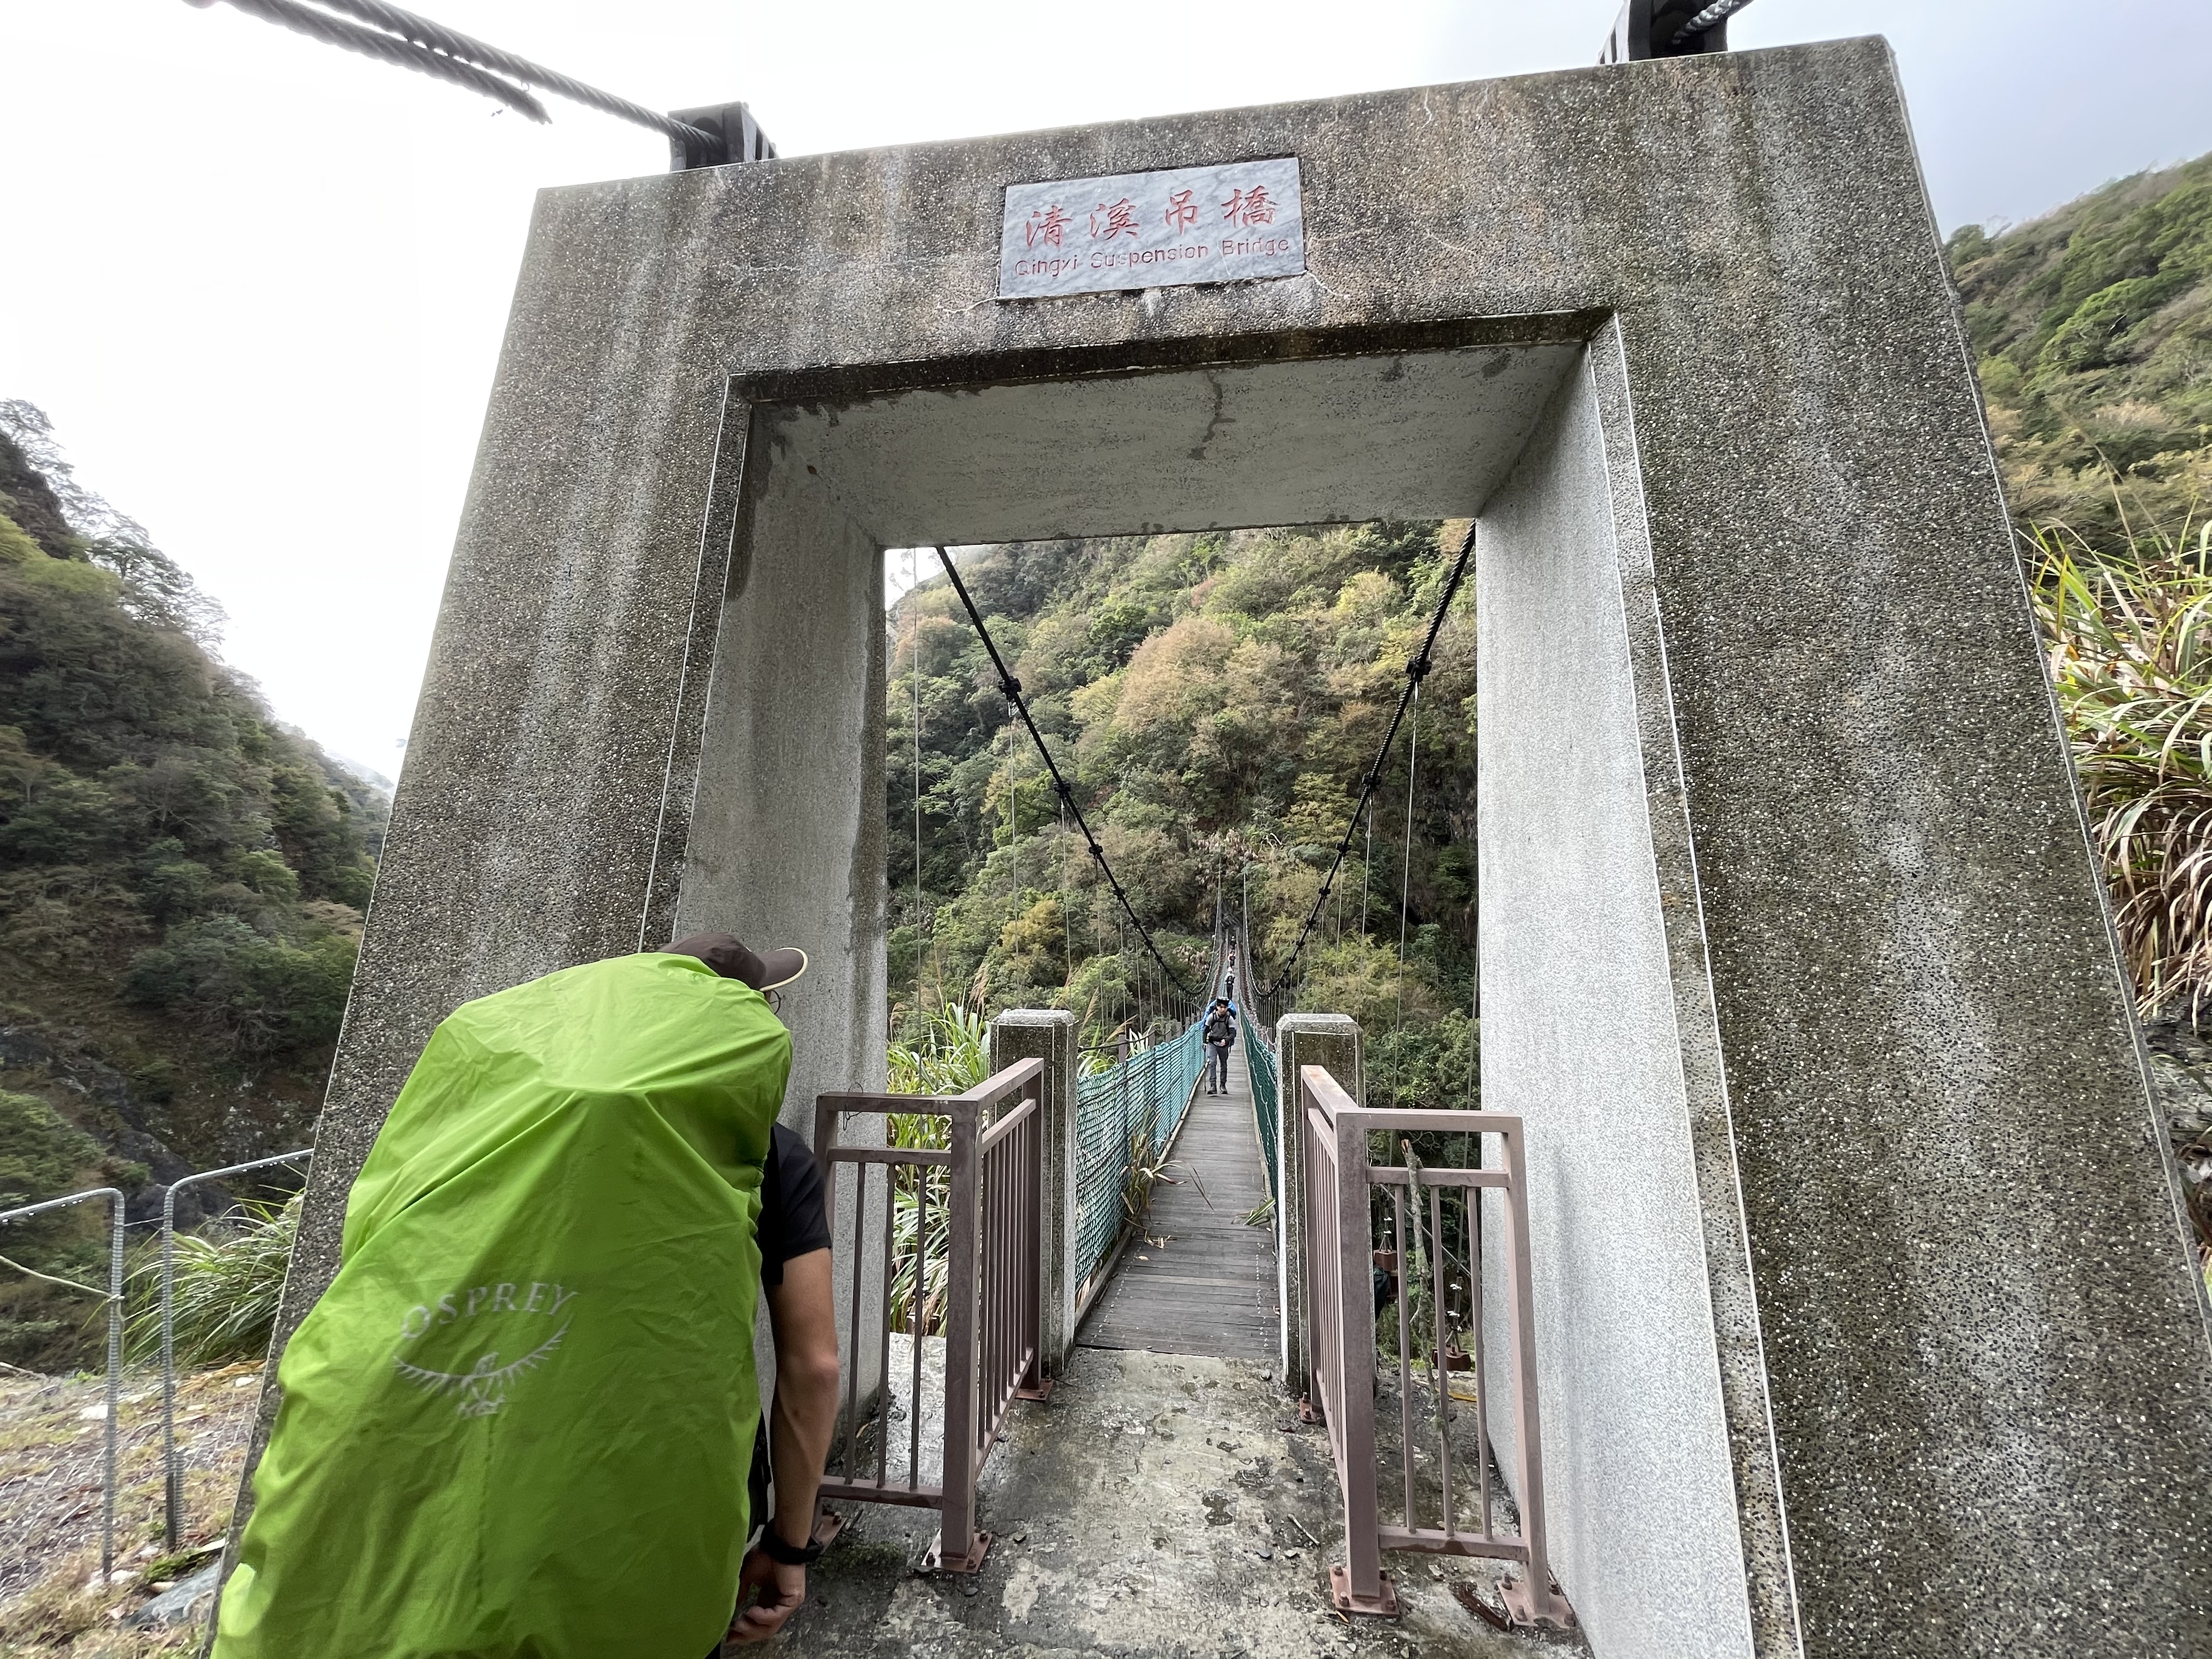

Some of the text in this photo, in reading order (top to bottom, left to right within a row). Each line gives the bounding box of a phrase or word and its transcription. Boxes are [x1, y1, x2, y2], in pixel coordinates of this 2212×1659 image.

[1025, 185, 1280, 249] 清溪吊橋
[1014, 237, 1289, 278] Qingxi Suspension Bridge
[401, 1280, 579, 1339] OSPREY
